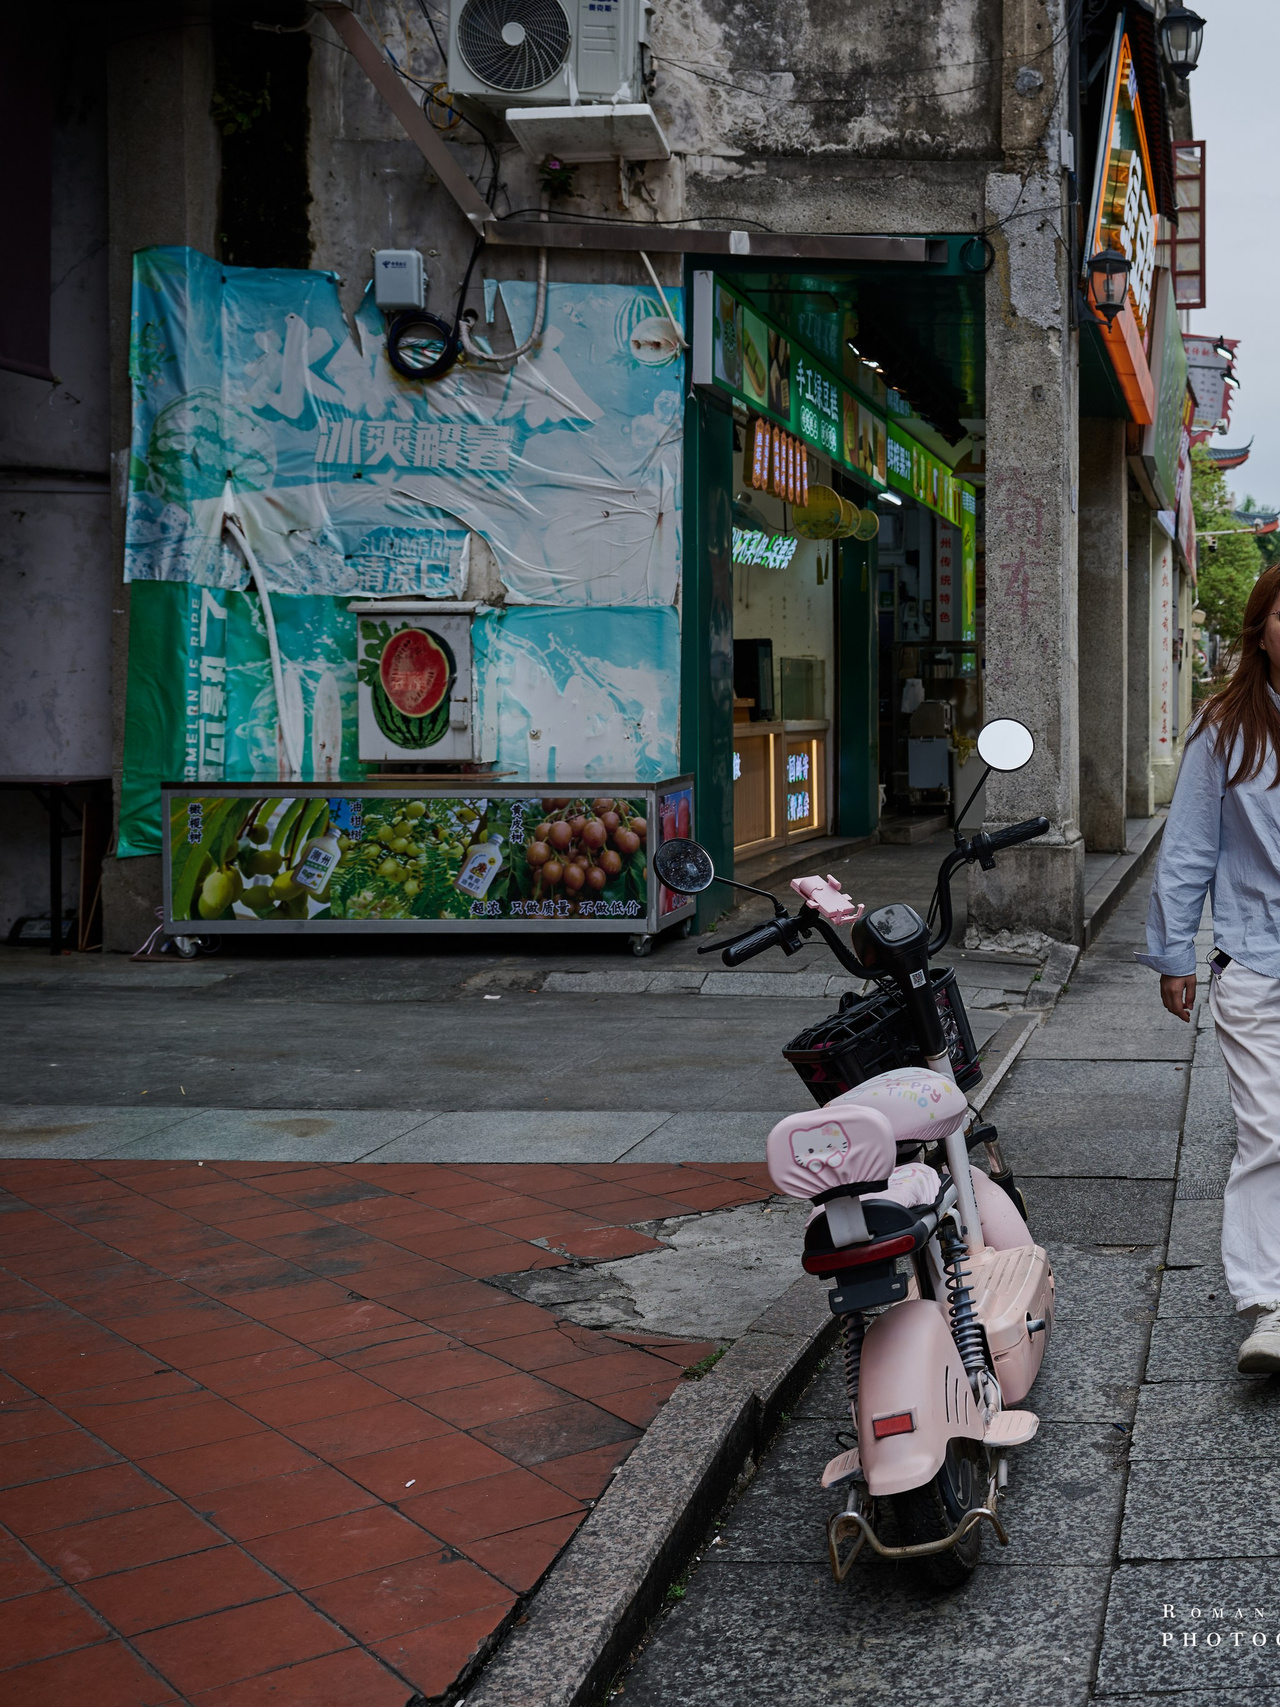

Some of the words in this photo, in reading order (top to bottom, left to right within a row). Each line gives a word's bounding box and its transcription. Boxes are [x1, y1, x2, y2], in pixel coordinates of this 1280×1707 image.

[314, 417, 510, 471] 冰爽解暑
[359, 536, 444, 559] SUMMER
[190, 598, 200, 647] RIPE
[511, 803, 524, 844] 黄皮树
[510, 900, 571, 916] 只做质量
[579, 899, 641, 916] 不做低价
